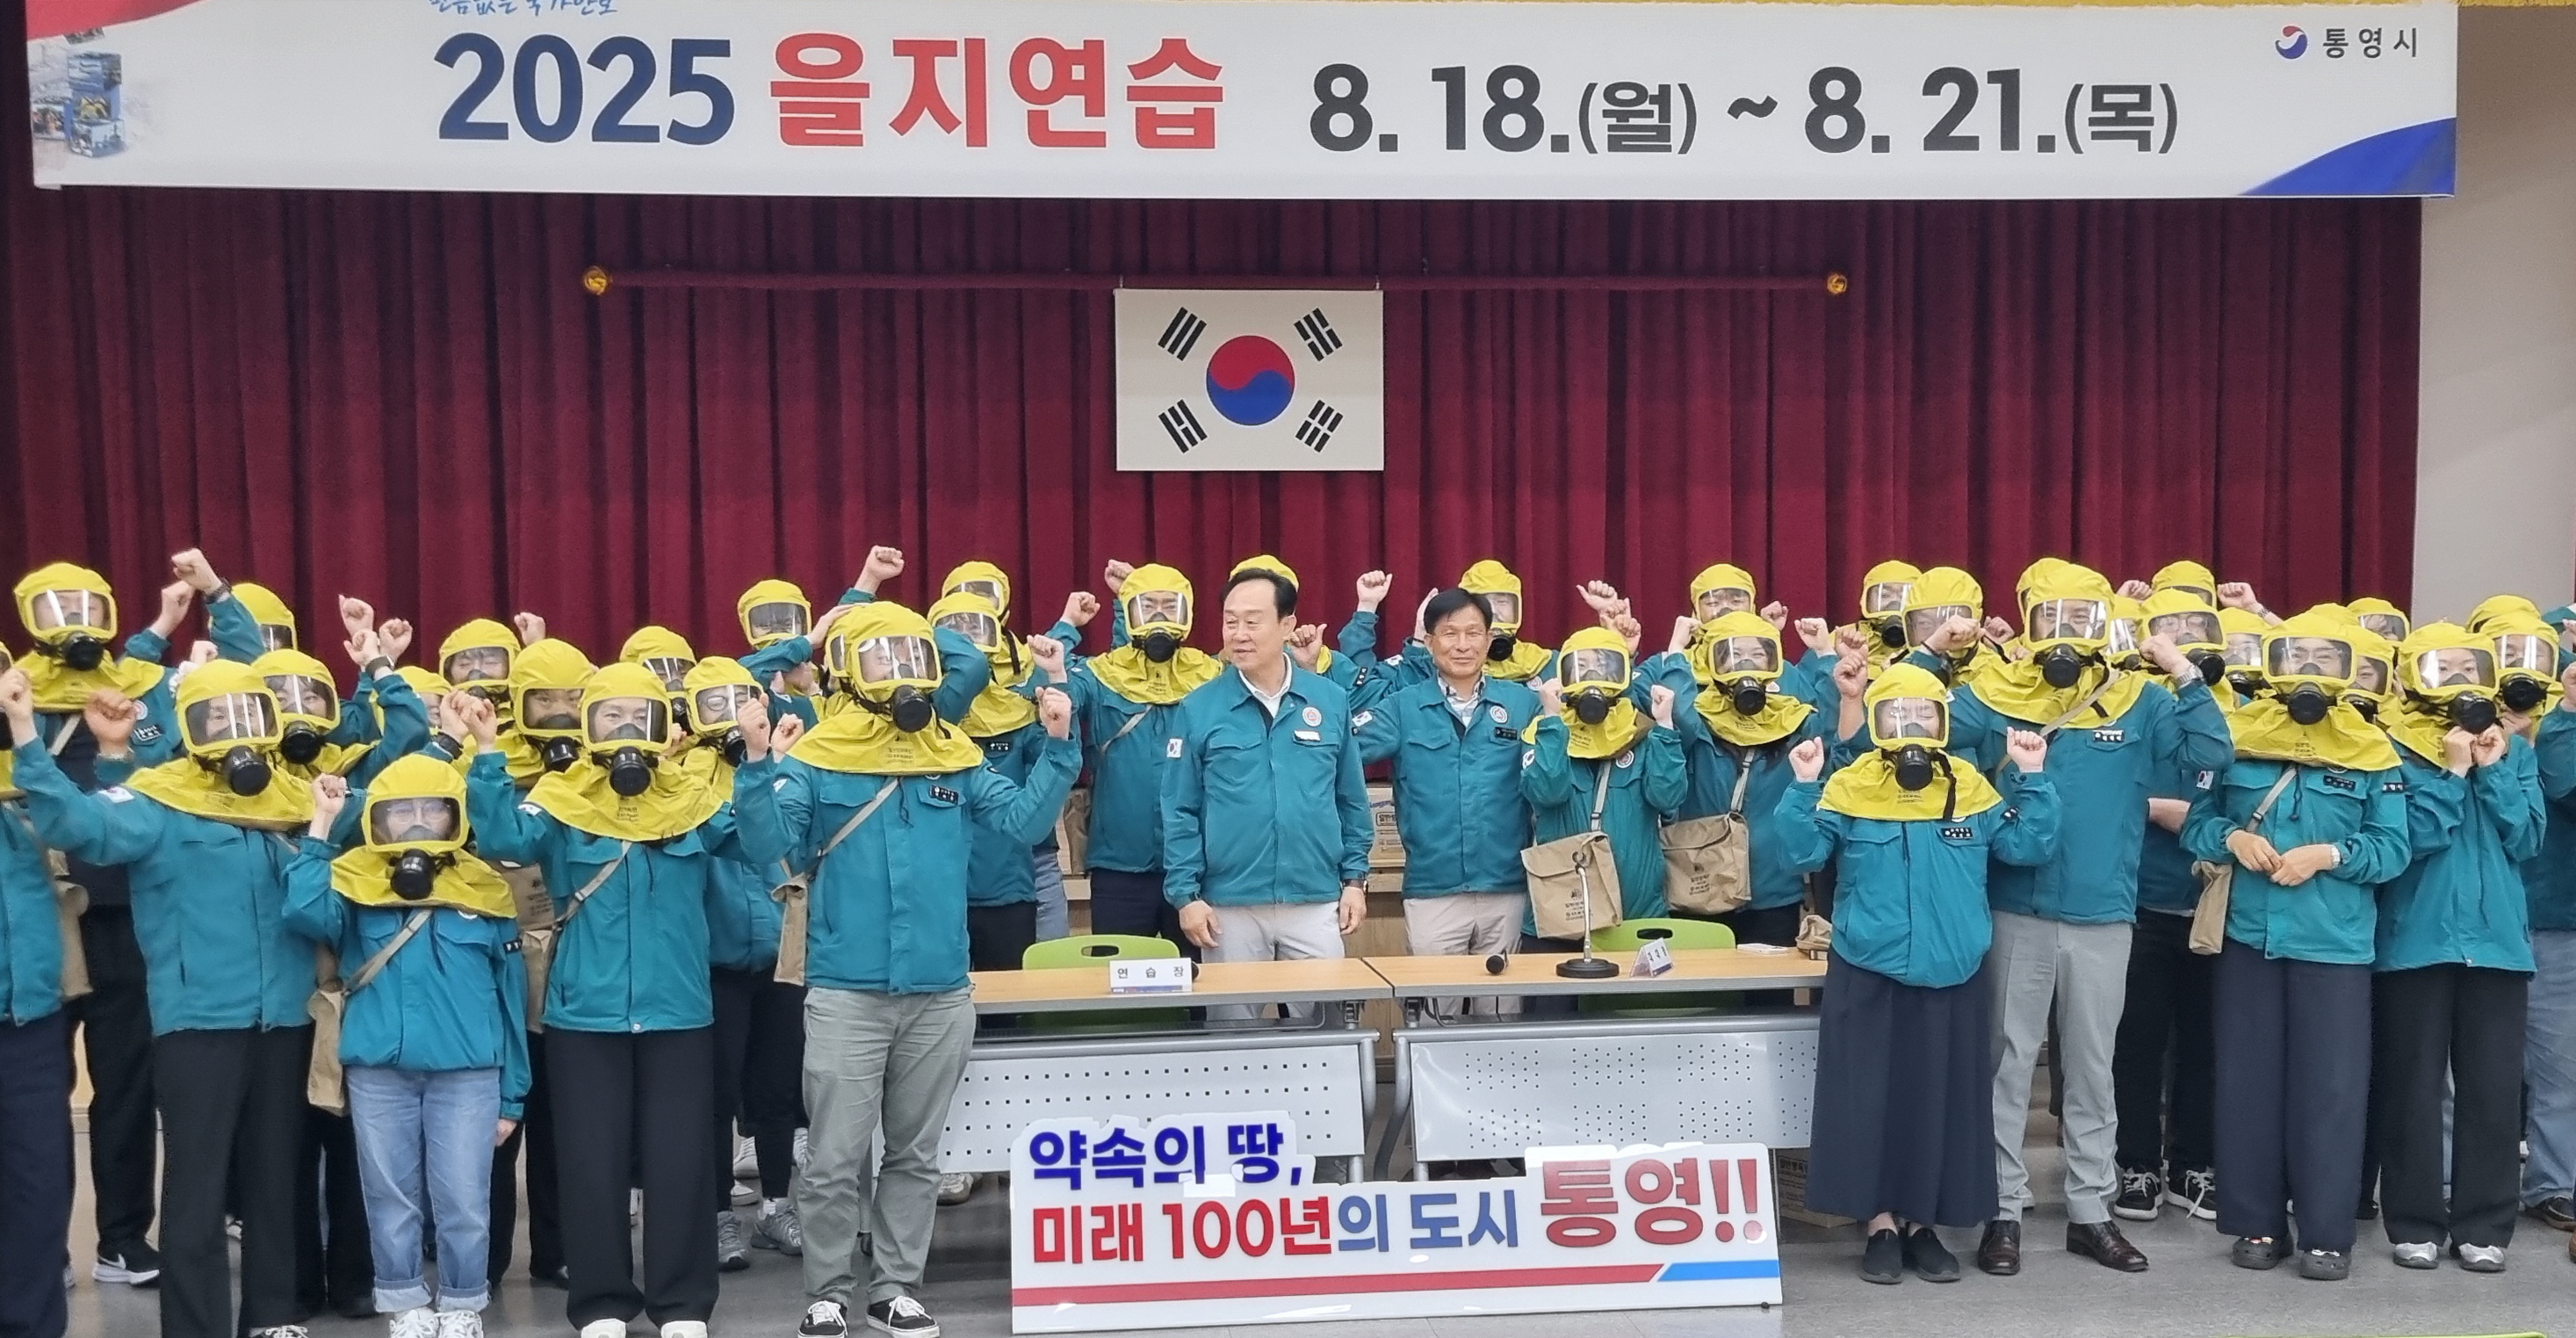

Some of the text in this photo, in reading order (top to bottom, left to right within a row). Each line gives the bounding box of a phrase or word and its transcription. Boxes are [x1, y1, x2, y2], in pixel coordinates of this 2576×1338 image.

[2322, 26, 2418, 59] 통영시
[434, 33, 735, 146] 2025
[769, 33, 1224, 149] 을지연습
[1310, 63, 1398, 153] 8.
[1431, 64, 1698, 155] 18.(월)
[1804, 66, 1891, 154] 8.
[1921, 67, 2179, 155] 21.(목)
[1028, 1121, 1302, 1190] 약속의 땅,
[1032, 1198, 1144, 1263] 미래
[1161, 1192, 1390, 1259] 100년의
[1409, 1190, 1519, 1250] 도시
[1539, 1157, 1764, 1249] 통영!!
